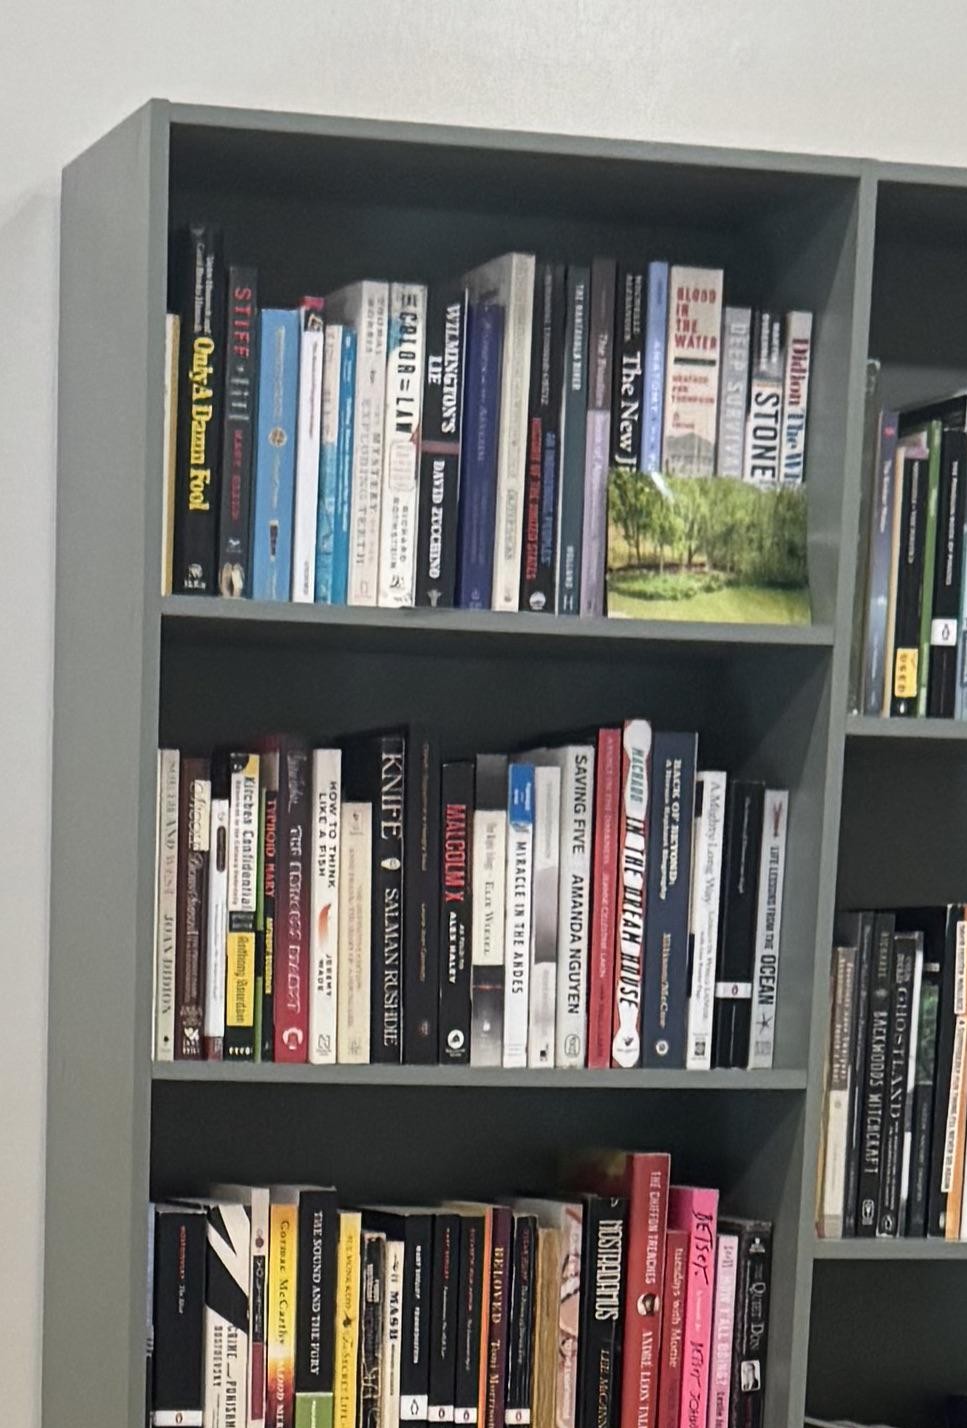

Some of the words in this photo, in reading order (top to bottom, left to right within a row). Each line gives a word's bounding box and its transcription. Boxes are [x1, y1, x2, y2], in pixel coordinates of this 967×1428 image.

[676, 287, 717, 303] BLOOD
[676, 303, 688, 318] IN
[234, 287, 252, 358] STIFF
[398, 312, 418, 375] COLOR
[675, 318, 698, 335] THE
[675, 334, 718, 350] WATER
[189, 337, 214, 385] Only
[428, 356, 442, 384] LIE
[442, 304, 461, 433] WILMINGTON'S
[788, 338, 810, 406] Didion
[192, 383, 210, 399] A
[190, 405, 212, 464] Damn
[395, 397, 413, 433] LAW
[787, 413, 806, 448] The
[188, 468, 211, 510] Fool
[432, 460, 445, 503] DAVID
[429, 507, 444, 579] ZUCCHINO
[381, 753, 402, 840] KNIFE
[574, 755, 587, 814] SAVING
[630, 748, 644, 803] MACHADO
[319, 792, 327, 824] LIKE
[329, 781, 338, 816] HOW
[319, 829, 326, 839] A
[328, 822, 337, 839] TO
[445, 805, 466, 886] MALCOLM
[572, 819, 586, 854] FIVE
[626, 818, 642, 835] IN
[318, 845, 326, 877] FISH
[327, 845, 337, 888] THINK
[515, 842, 527, 898] MIRACLE
[624, 846, 643, 877] THE
[445, 888, 464, 902] X
[514, 904, 525, 918] IN
[570, 875, 584, 944] AMANDA
[622, 886, 642, 945] DREAM
[384, 888, 398, 966] SALMAN
[513, 923, 525, 946] THE
[511, 952, 524, 994] ANDES
[568, 949, 582, 1014] NGUYEN
[619, 953, 638, 1008] HOUSE
[383, 969, 398, 1046] RUSHDIE
[871, 1011, 887, 1086] BACKWOODS
[865, 1093, 882, 1174] WITCHCRAFT
[313, 1211, 323, 1236] THE
[279, 1220, 290, 1271] Cormac
[312, 1240, 322, 1283] SOUND
[492, 1247, 505, 1323] BELOVED
[595, 1220, 623, 1320] NOSTRADAMUS
[672, 1248, 685, 1296] tuesdays
[277, 1279, 289, 1345] McCarthy
[311, 1285, 321, 1312] AND
[389, 1291, 399, 1340] MASH
[670, 1300, 683, 1325] with
[311, 1316, 321, 1341] THE
[669, 1328, 682, 1367] Morrie
[310, 1343, 320, 1375] FURY
[491, 1339, 500, 1369] Toni
